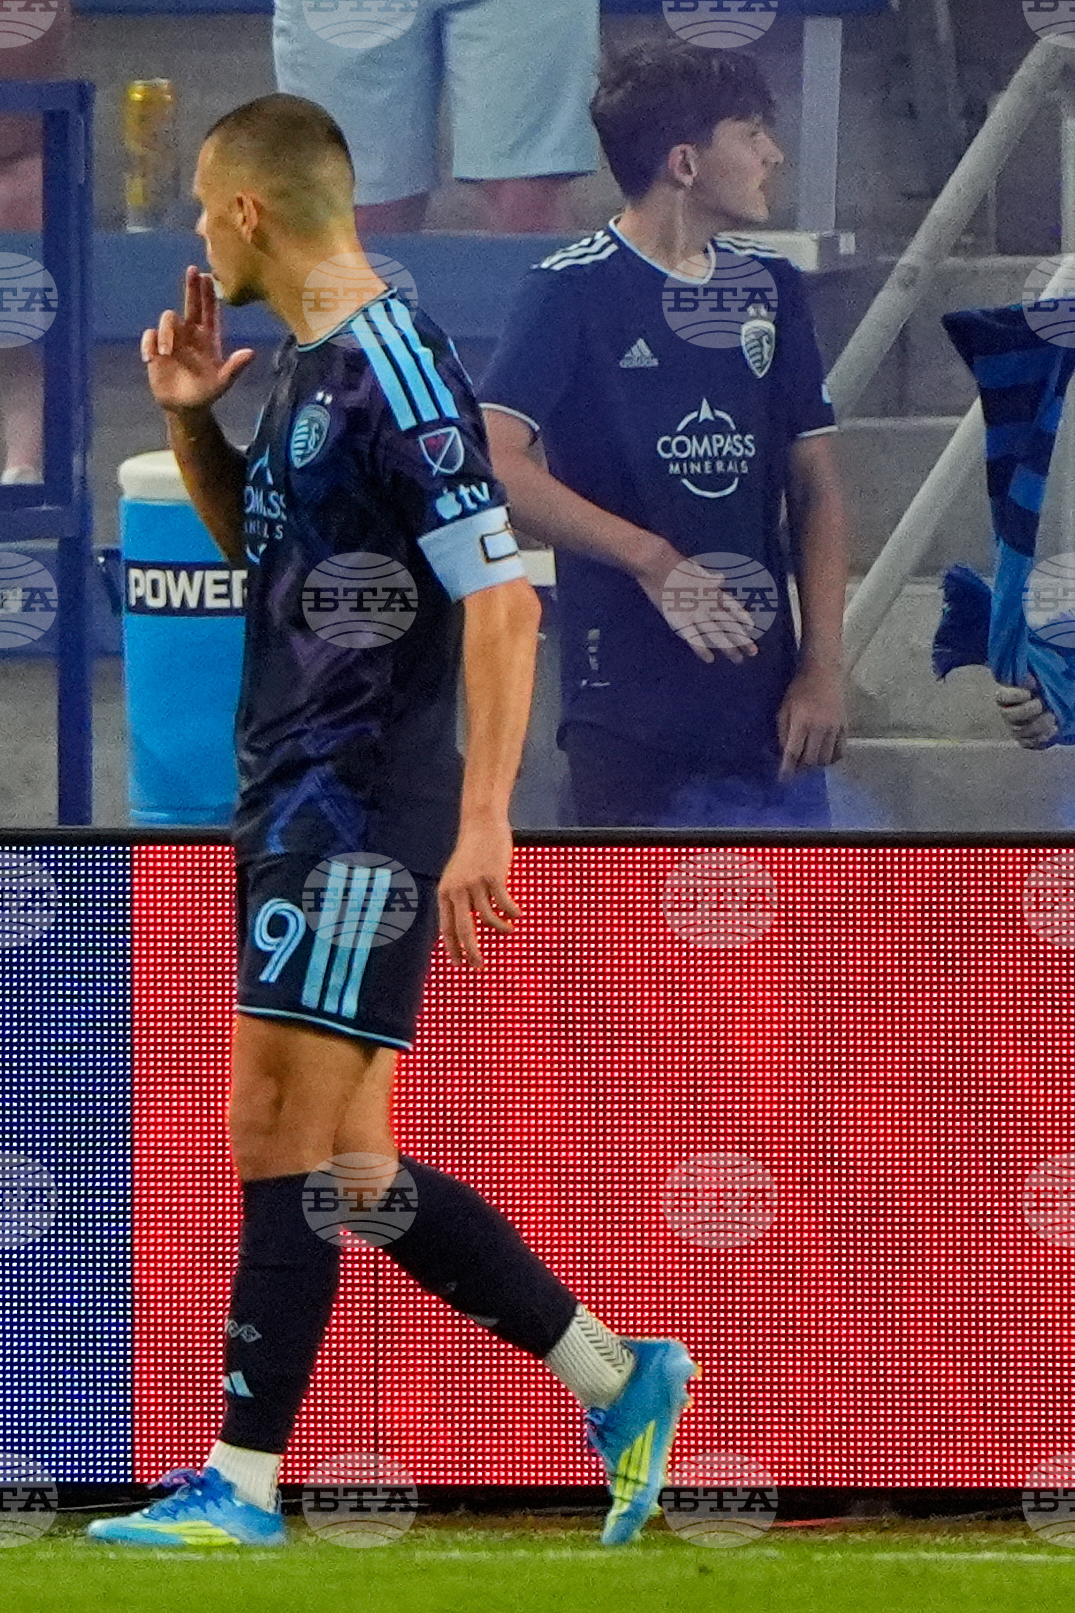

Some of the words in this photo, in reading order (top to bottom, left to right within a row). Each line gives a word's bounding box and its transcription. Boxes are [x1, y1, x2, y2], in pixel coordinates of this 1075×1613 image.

[656, 434, 756, 459] COMPASS
[668, 460, 749, 475] MINERALS
[459, 481, 491, 510] tv
[254, 897, 306, 984] 9
